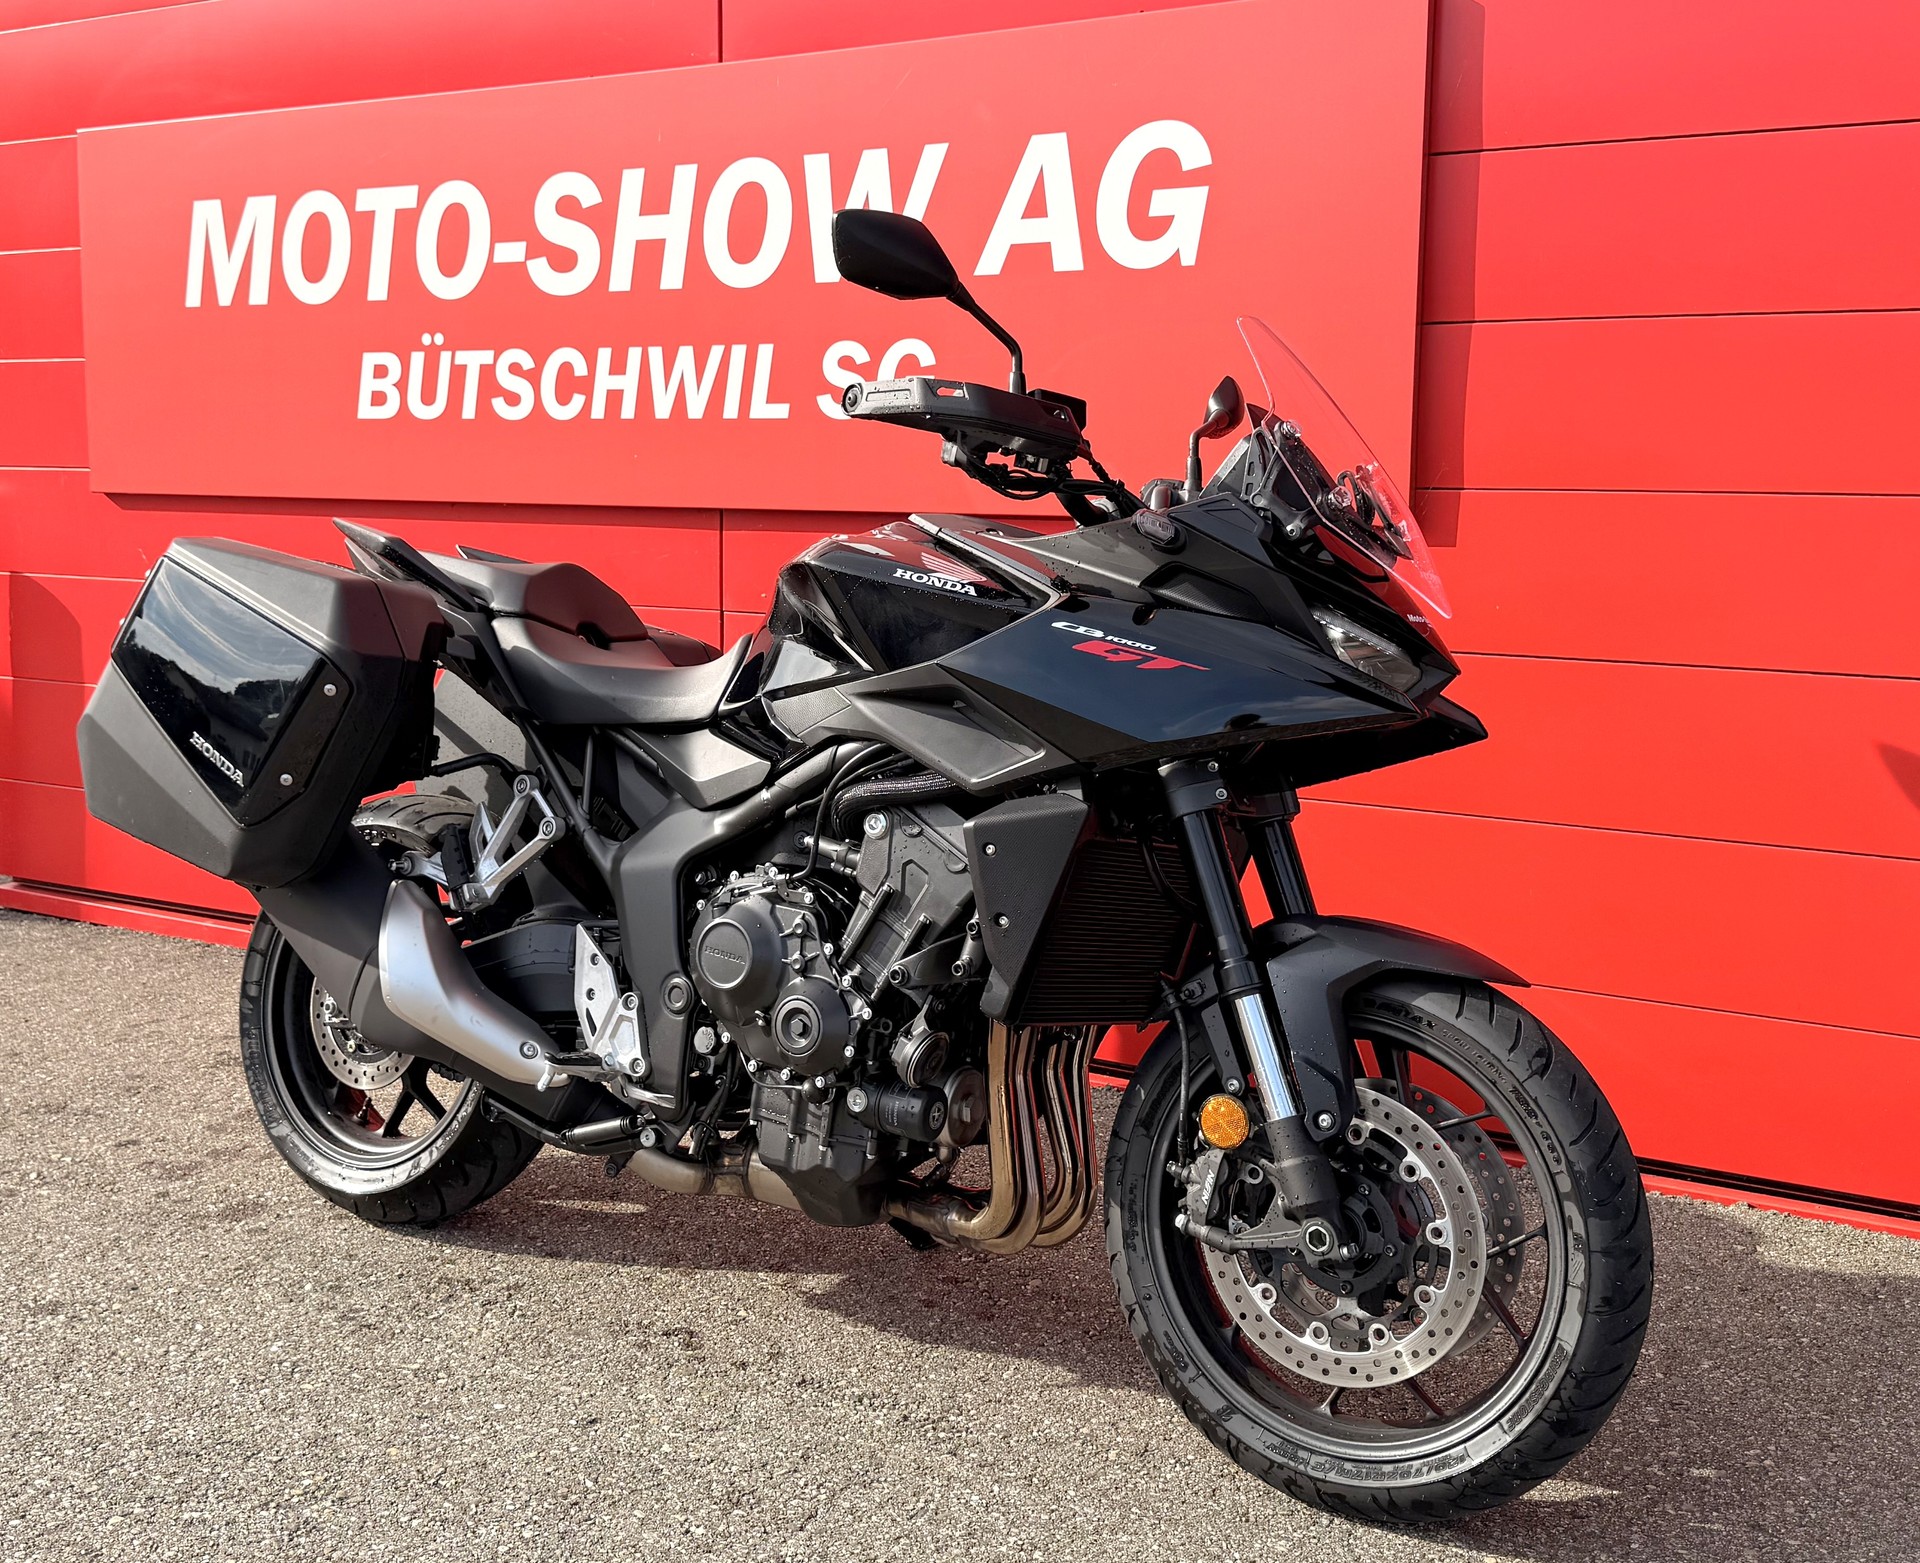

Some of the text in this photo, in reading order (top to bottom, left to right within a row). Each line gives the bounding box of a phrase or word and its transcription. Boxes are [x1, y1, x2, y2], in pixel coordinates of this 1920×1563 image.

[185, 119, 1213, 308] MOTO-SHOW AG
[357, 332, 790, 420] BÜTSCHWIL
[893, 568, 978, 597] HONDA
[1051, 621, 1157, 651] CB 1000
[1072, 640, 1212, 671] GT
[189, 731, 245, 788] HONDA
